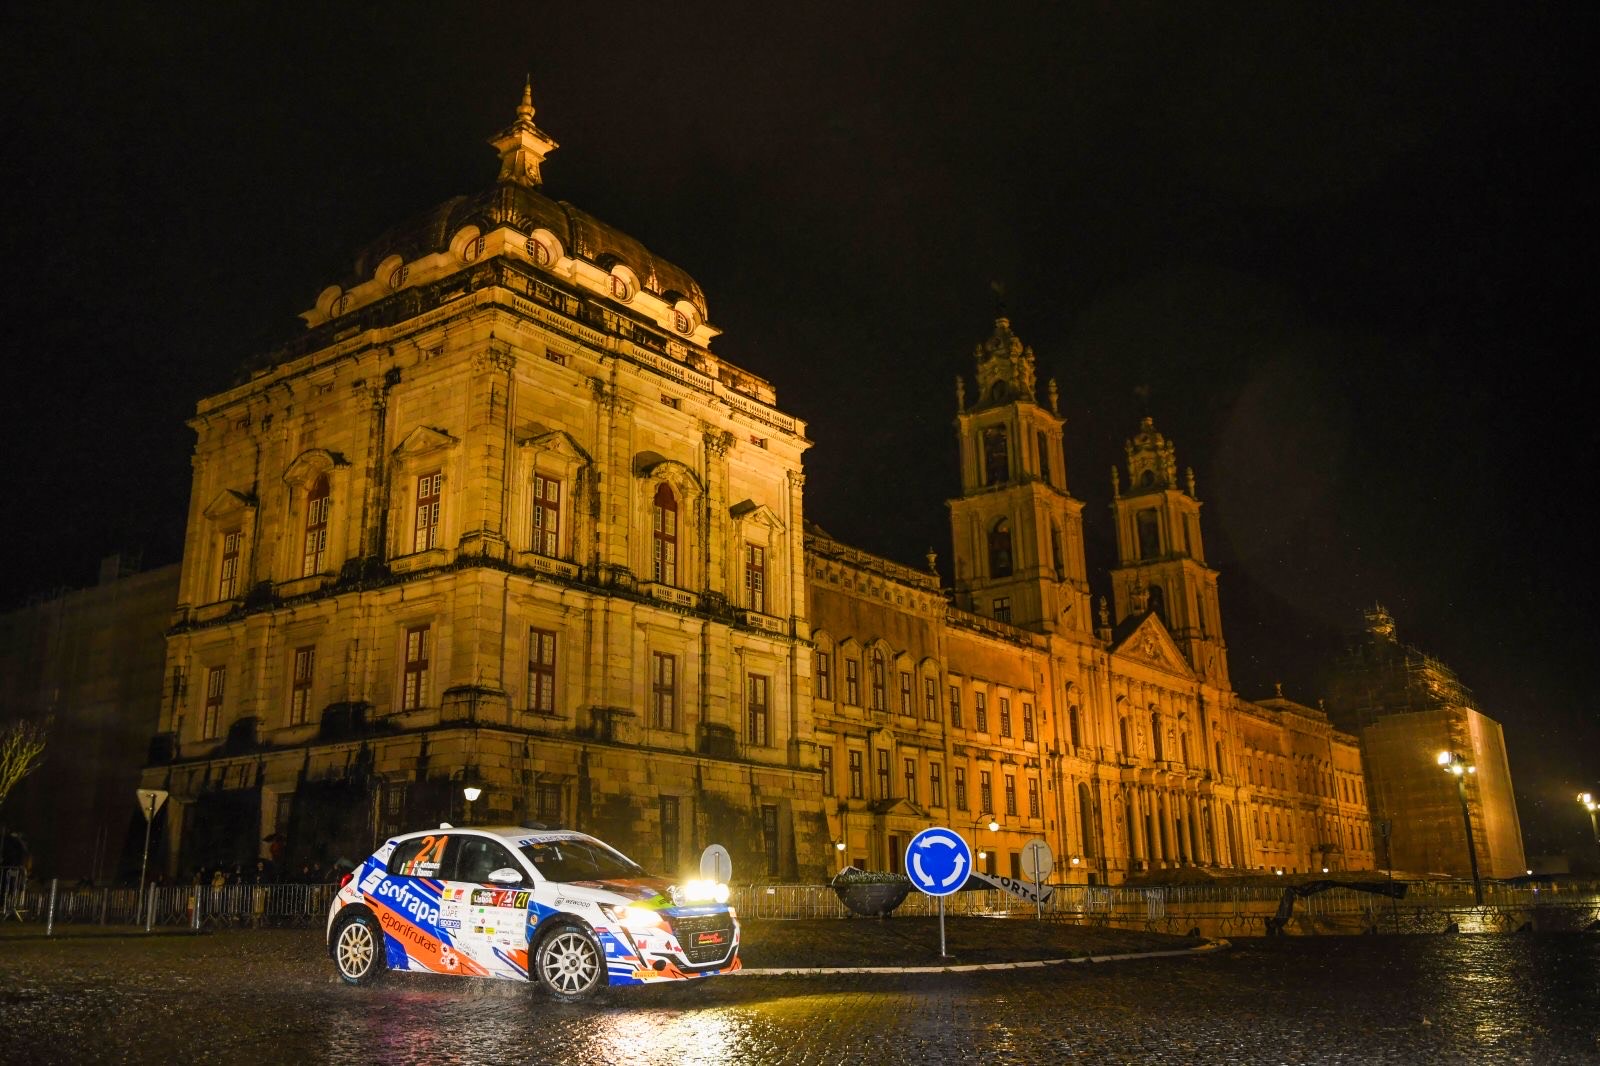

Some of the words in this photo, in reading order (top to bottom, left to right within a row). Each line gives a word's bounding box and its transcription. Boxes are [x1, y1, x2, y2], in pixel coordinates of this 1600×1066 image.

[413, 835, 449, 863] 21
[378, 880, 440, 926] sofrapa
[515, 892, 529, 908] 21
[381, 912, 438, 954] eporifrutas
